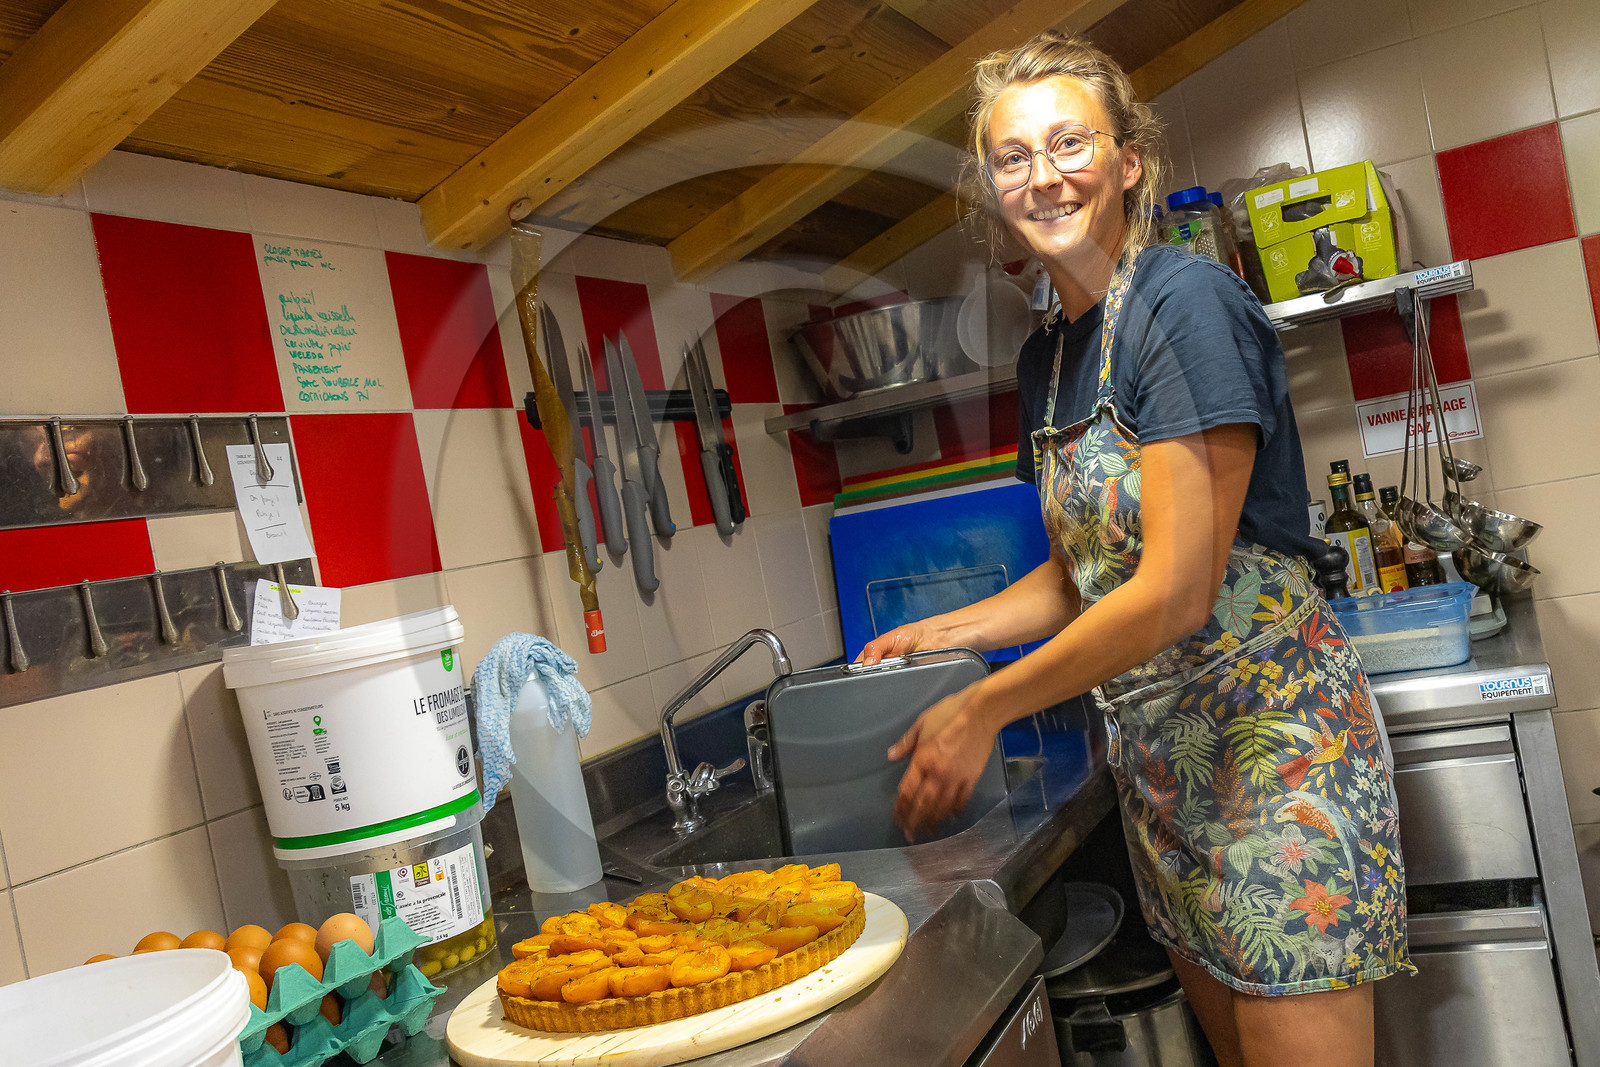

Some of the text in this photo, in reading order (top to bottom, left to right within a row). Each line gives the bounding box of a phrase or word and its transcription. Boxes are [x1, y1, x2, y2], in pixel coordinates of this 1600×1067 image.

[1366, 408, 1407, 427] VANNE
[1407, 421, 1433, 437] GAZ
[1480, 677, 1532, 692] TOURNUS
[1482, 687, 1532, 699] EQUIPEMENT
[413, 697, 426, 715] LE
[427, 686, 461, 712] FROMAGE
[436, 710, 449, 724] DES
[334, 802, 350, 812] 5 kg
[422, 891, 446, 904] provençale
